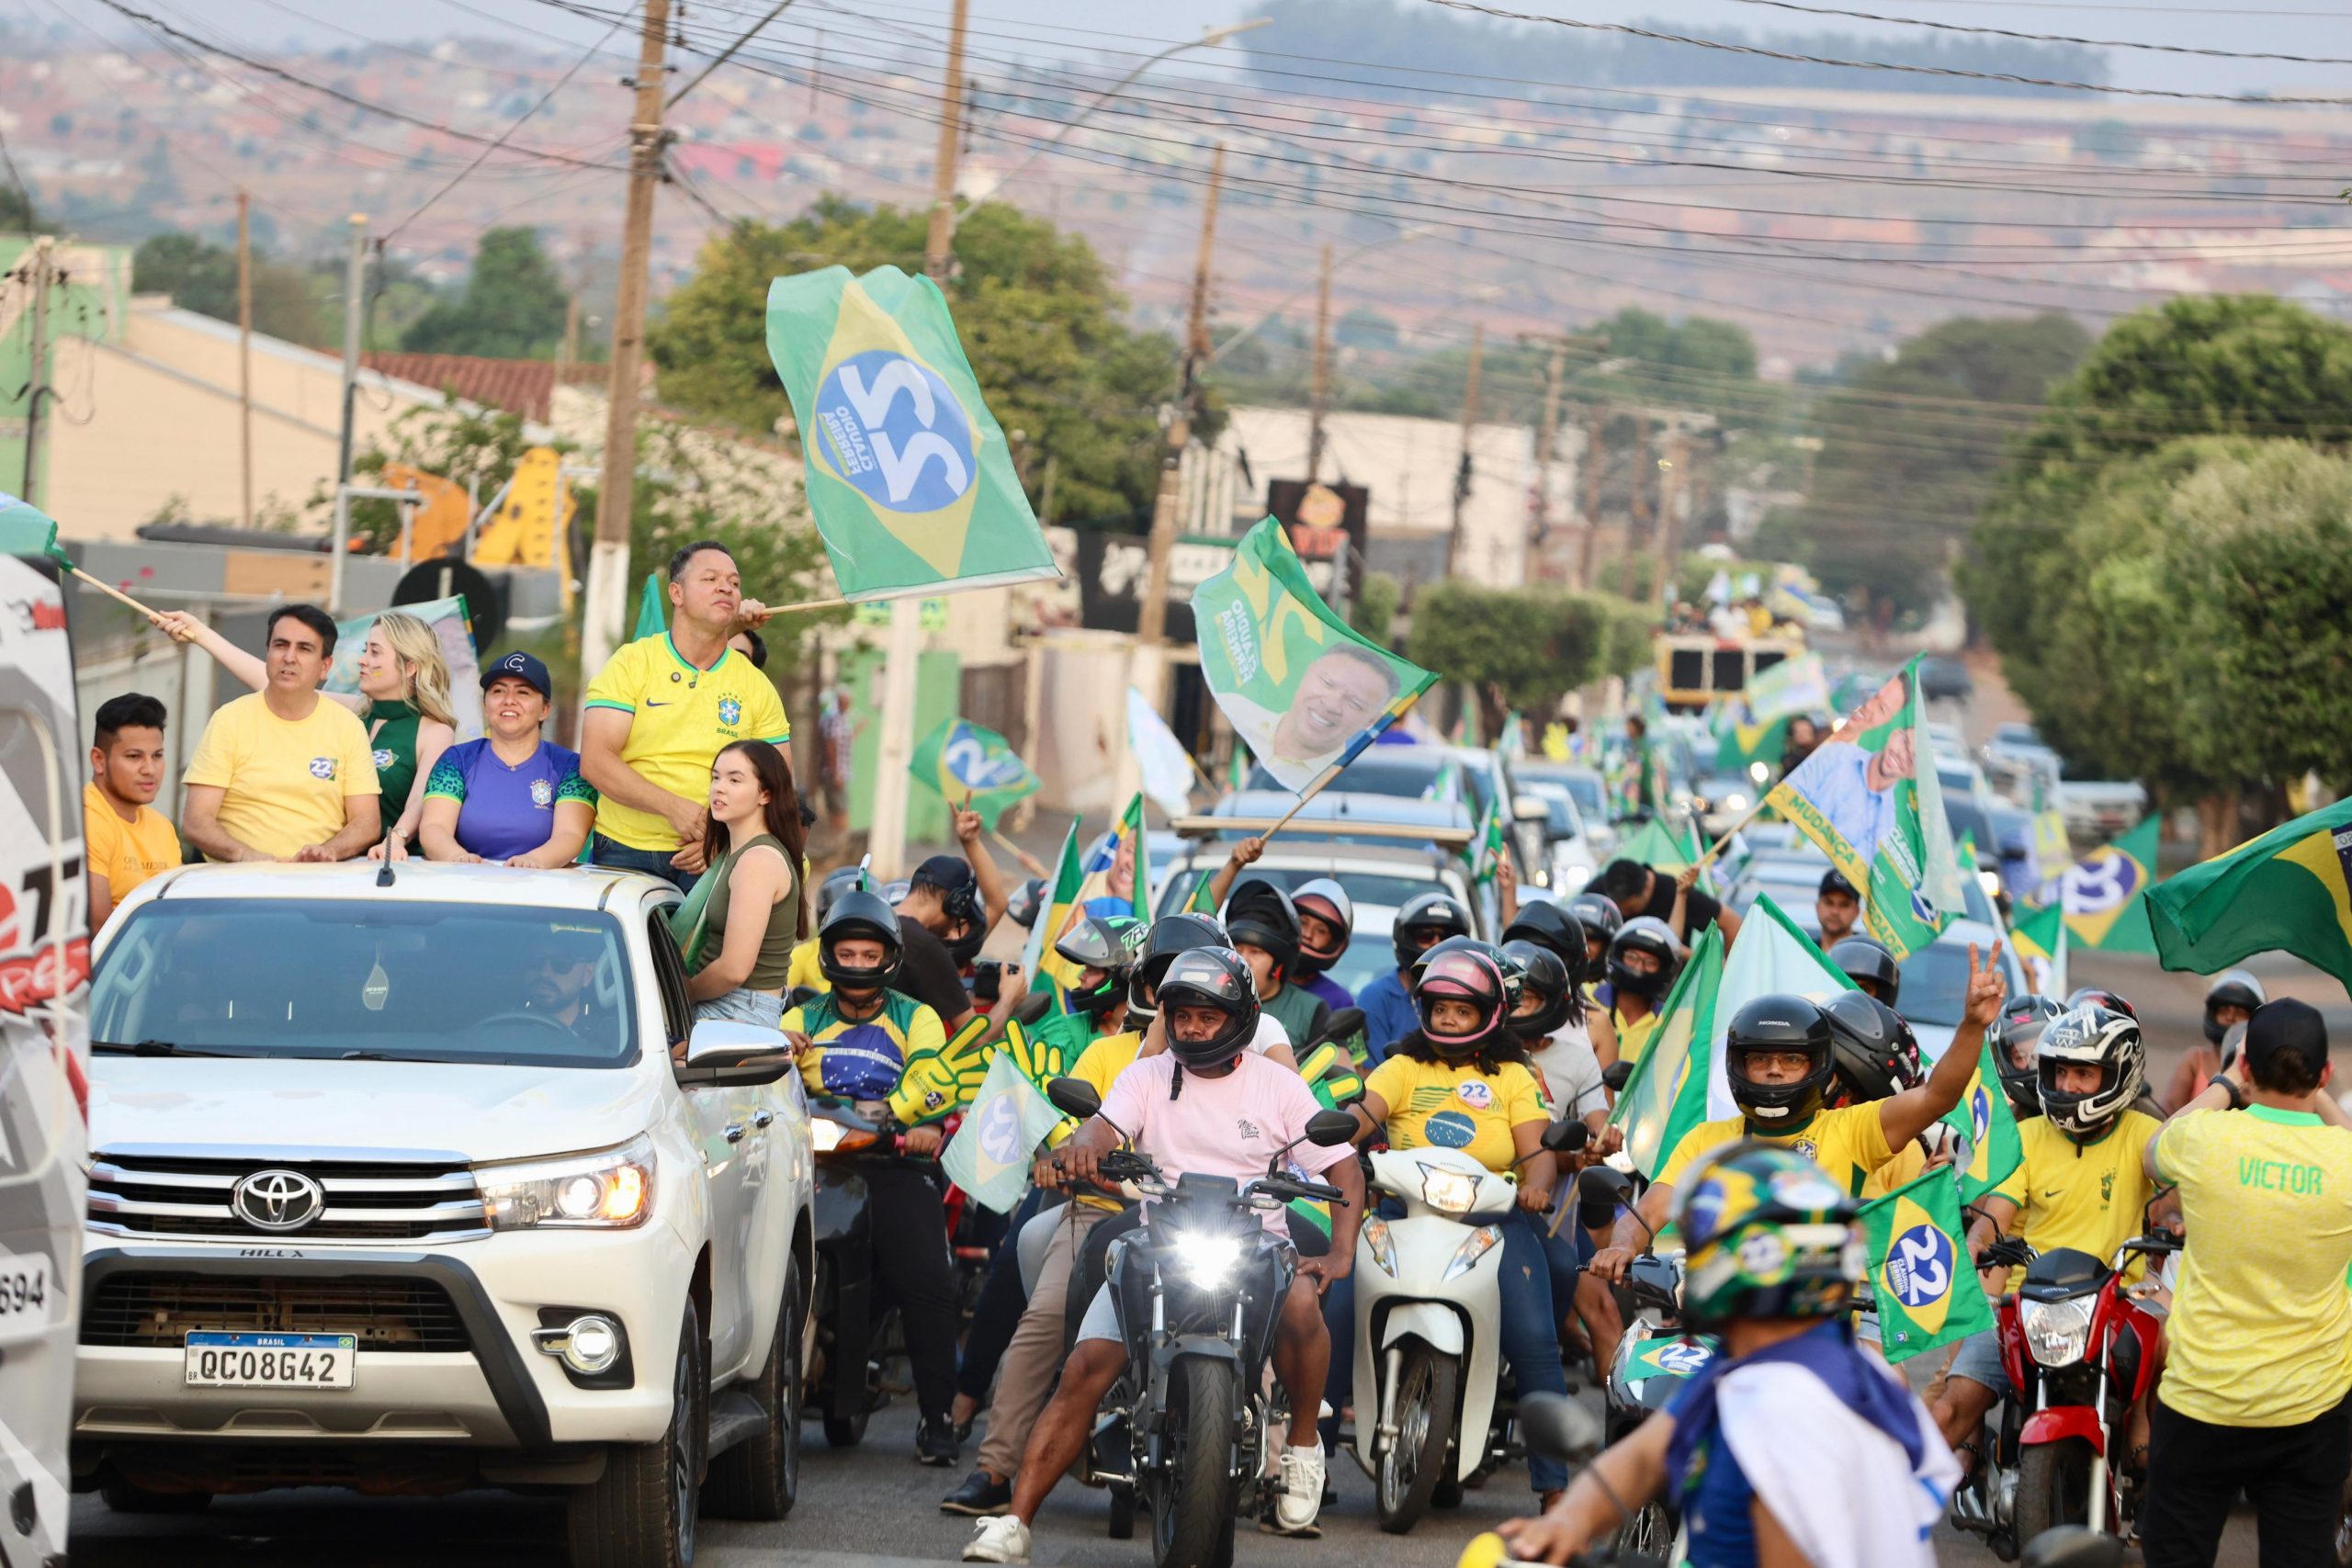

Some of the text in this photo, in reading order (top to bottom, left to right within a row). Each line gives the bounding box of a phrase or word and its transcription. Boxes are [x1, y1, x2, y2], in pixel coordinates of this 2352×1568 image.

[717, 728, 740, 738] BRASIL
[311, 760, 333, 773] 22
[1789, 795, 1856, 866] MUDANÇA
[1462, 1084, 1487, 1098] 22
[2239, 1156, 2323, 1195] VICTOR
[1887, 1259, 1905, 1297] FERREIRA
[1896, 1258, 1909, 1293] CLAUDIO
[1899, 1224, 1948, 1306] 22
[1661, 1343, 1710, 1368] 22
[188, 1371, 198, 1381] BR
